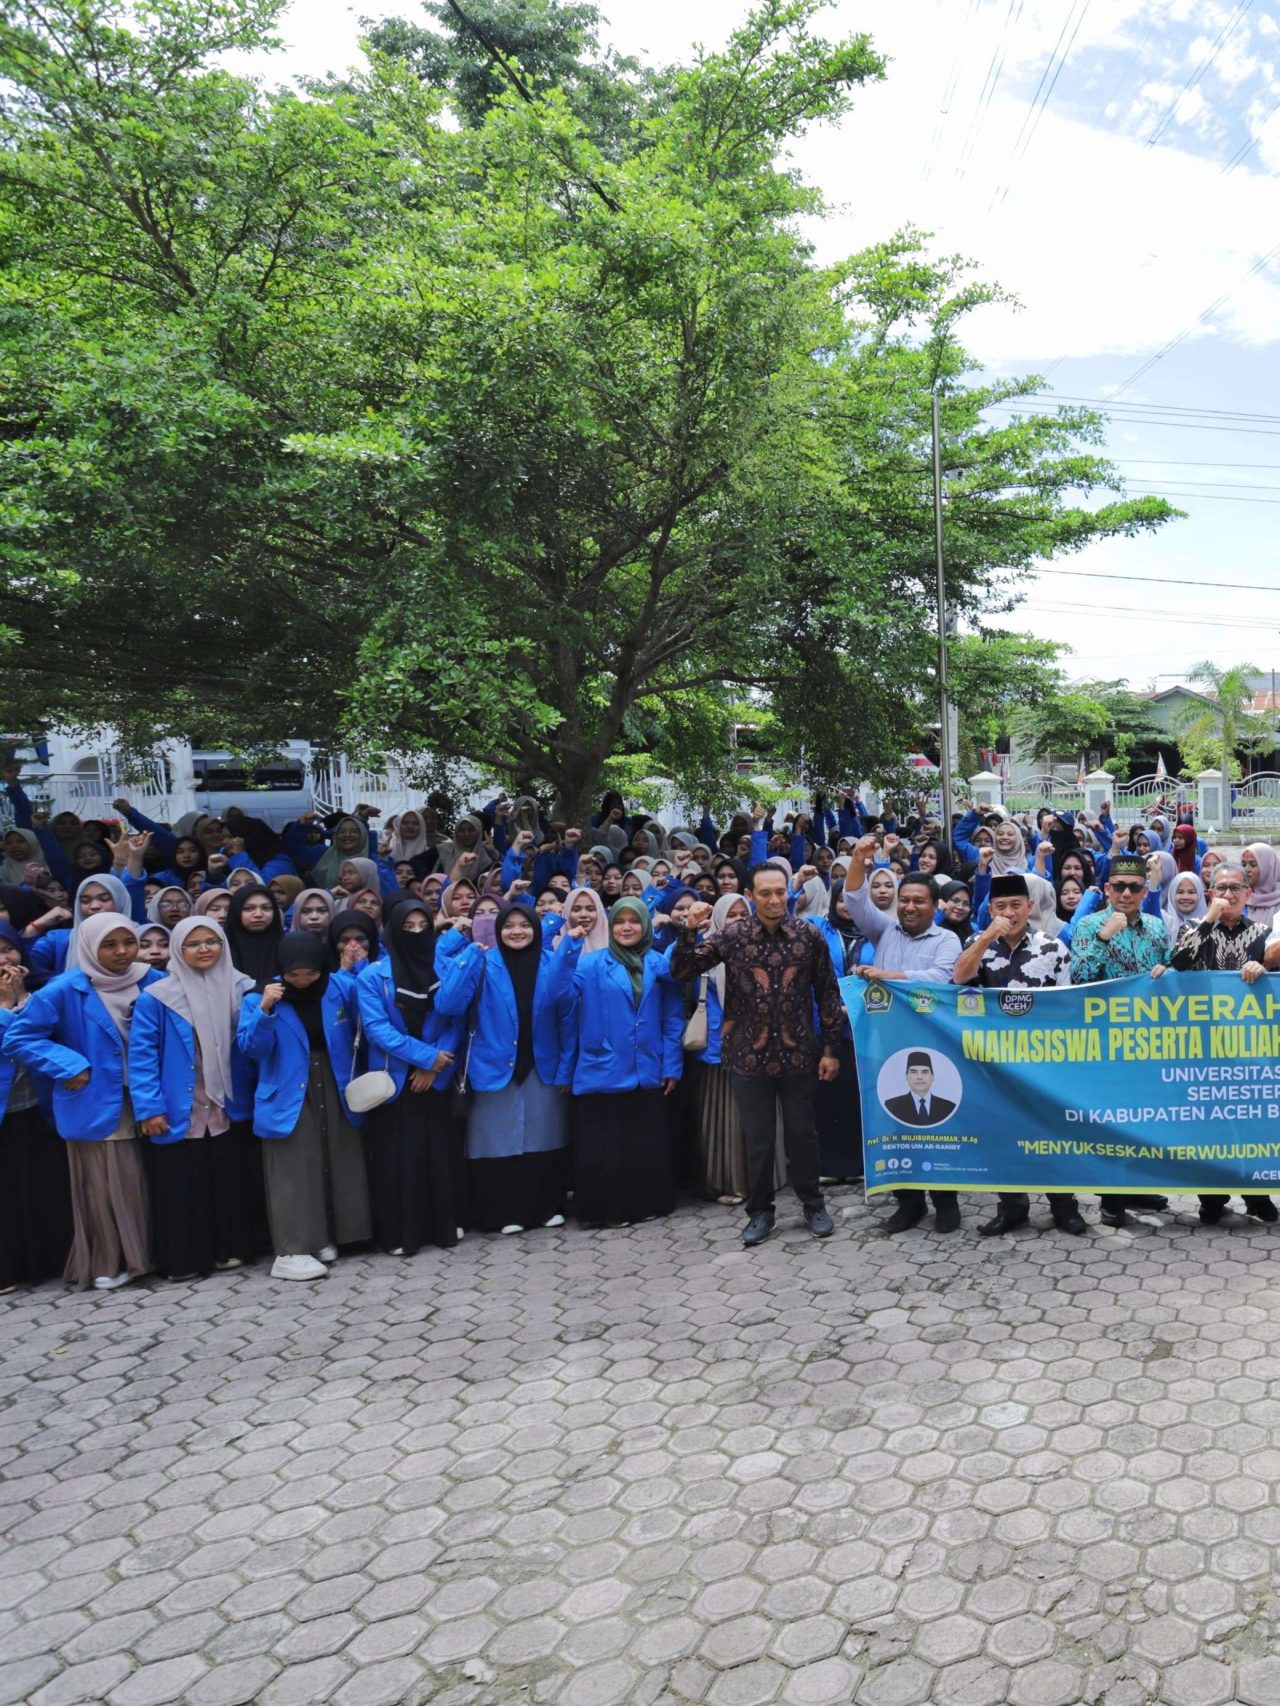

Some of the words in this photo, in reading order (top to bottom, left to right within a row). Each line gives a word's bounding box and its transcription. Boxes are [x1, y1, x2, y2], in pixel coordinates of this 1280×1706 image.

[1002, 1002, 1027, 1010] ACEH
[1005, 994, 1032, 1002] DPMG
[962, 1028, 1100, 1063] MAHASISWA
[1109, 1026, 1203, 1061] PESERTA
[1065, 1109, 1083, 1123] DI
[1089, 1106, 1204, 1124] KABUPATEN
[1210, 1104, 1261, 1120] ACEH
[1017, 1140, 1163, 1159] "MENYUKSESKAN
